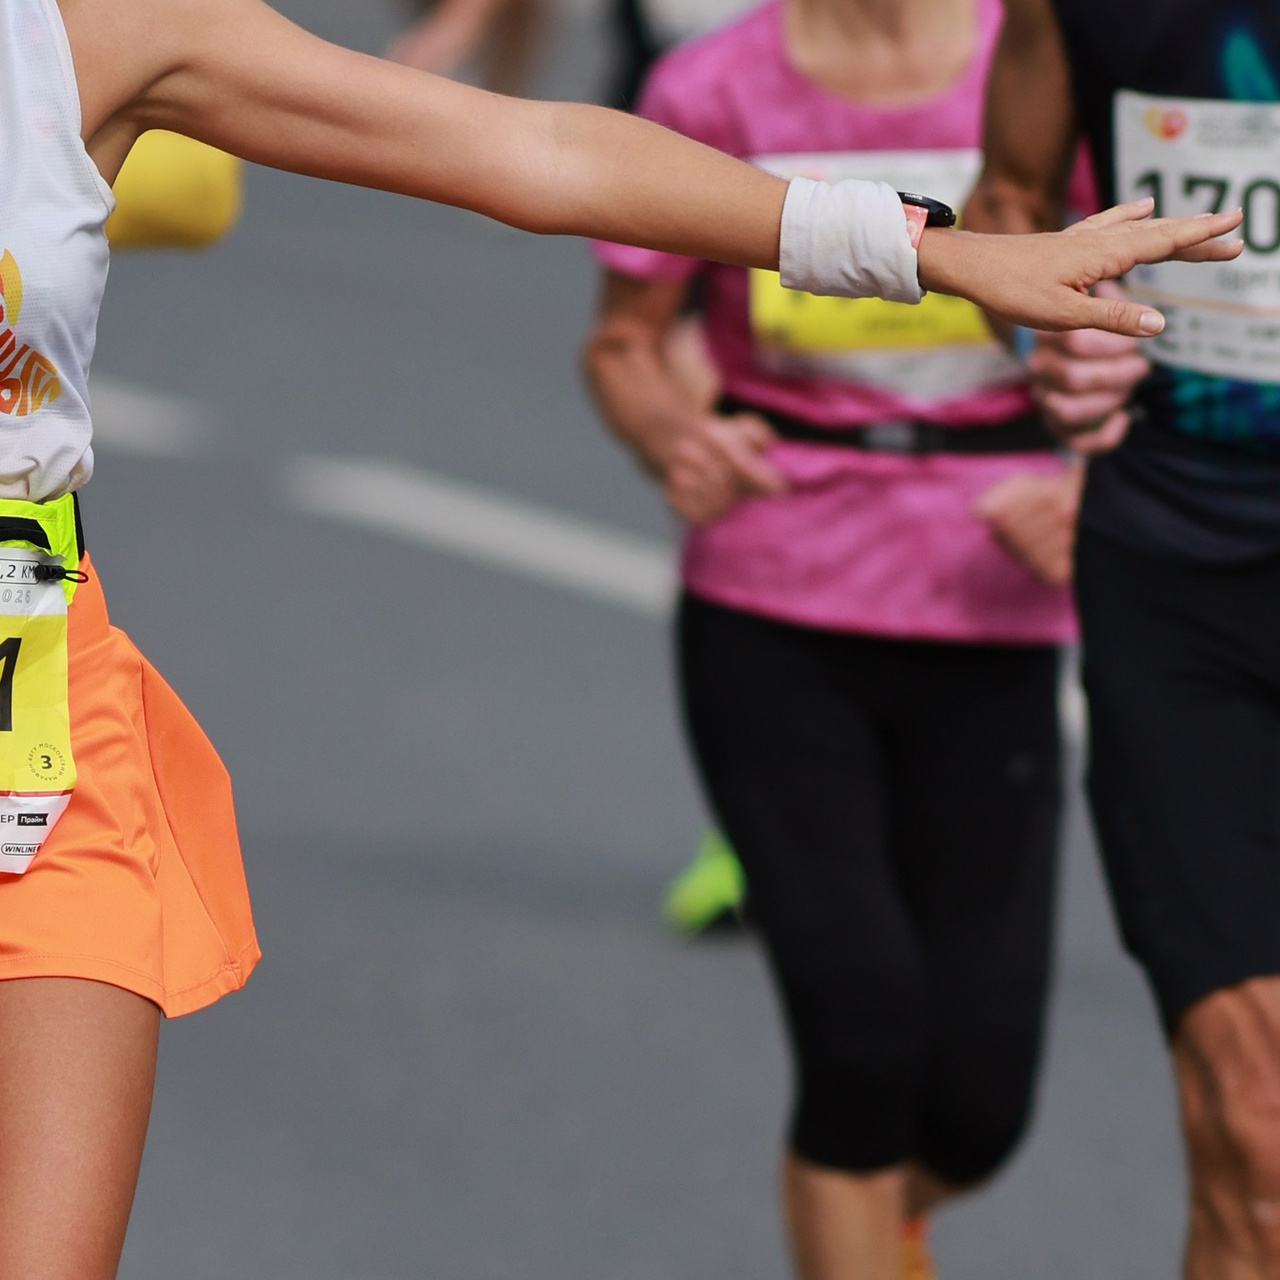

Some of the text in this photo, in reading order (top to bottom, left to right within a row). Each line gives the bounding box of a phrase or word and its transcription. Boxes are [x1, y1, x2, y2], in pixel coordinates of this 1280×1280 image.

[40, 755, 53, 769] 3
[20, 815, 44, 824] Прайм
[5, 845, 37, 853] WINLINE
